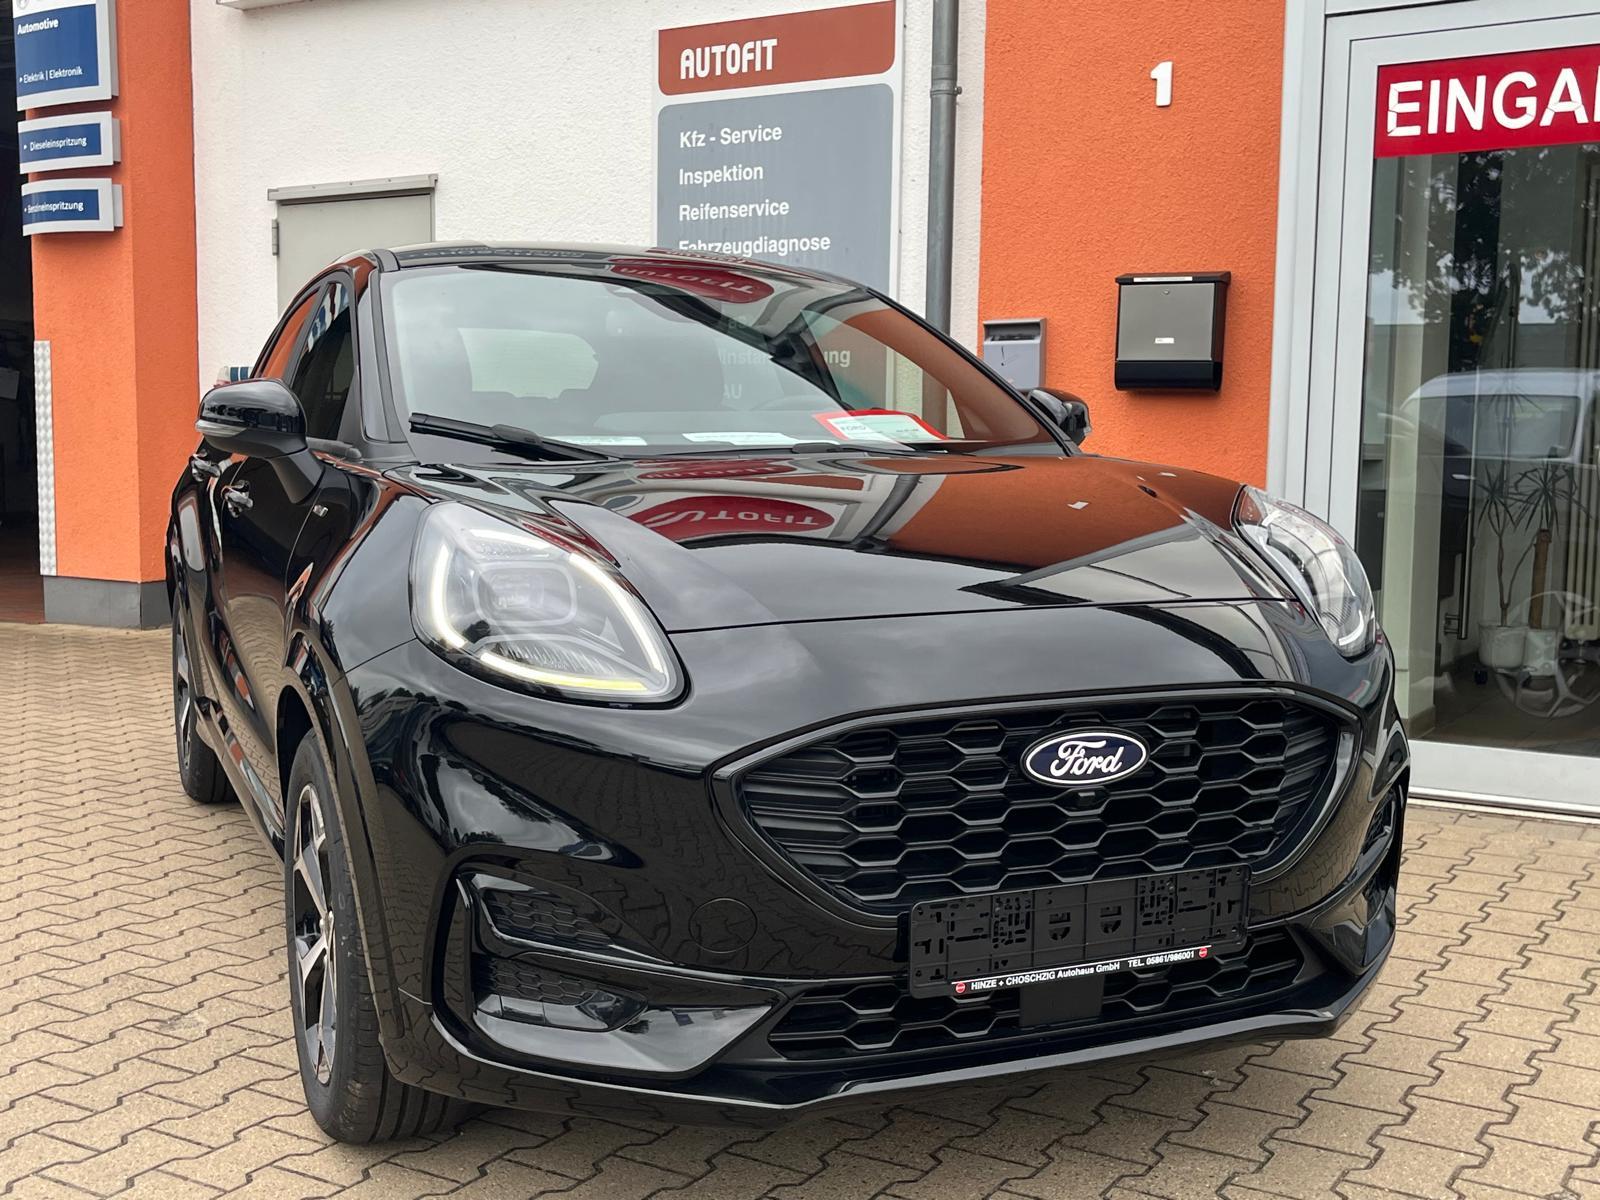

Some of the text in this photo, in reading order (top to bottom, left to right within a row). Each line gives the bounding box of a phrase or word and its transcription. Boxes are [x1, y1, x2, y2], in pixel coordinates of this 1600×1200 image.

[17, 18, 59, 35] Automotive
[680, 38, 778, 79] AUTOFIT
[23, 71, 45, 83] Elektrik
[49, 66, 83, 79] Elektronik
[1150, 61, 1173, 107] 1
[1387, 66, 1600, 137] EINGA
[30, 137, 87, 151] Dieseleinspritzung
[680, 131, 706, 148] Kfz
[720, 124, 782, 145] Service
[679, 164, 764, 187] Inspektion
[679, 199, 790, 221] Reifenservice
[678, 236, 831, 257] Fahrzeugdiagnose
[1049, 740, 1125, 777] Ford
[970, 979, 998, 990] HINZE
[1005, 972, 1055, 986] CHOSCHZIG
[1057, 966, 1094, 978] Autohaus
[1096, 962, 1120, 973] GmbH
[1128, 959, 1145, 968] TEL.
